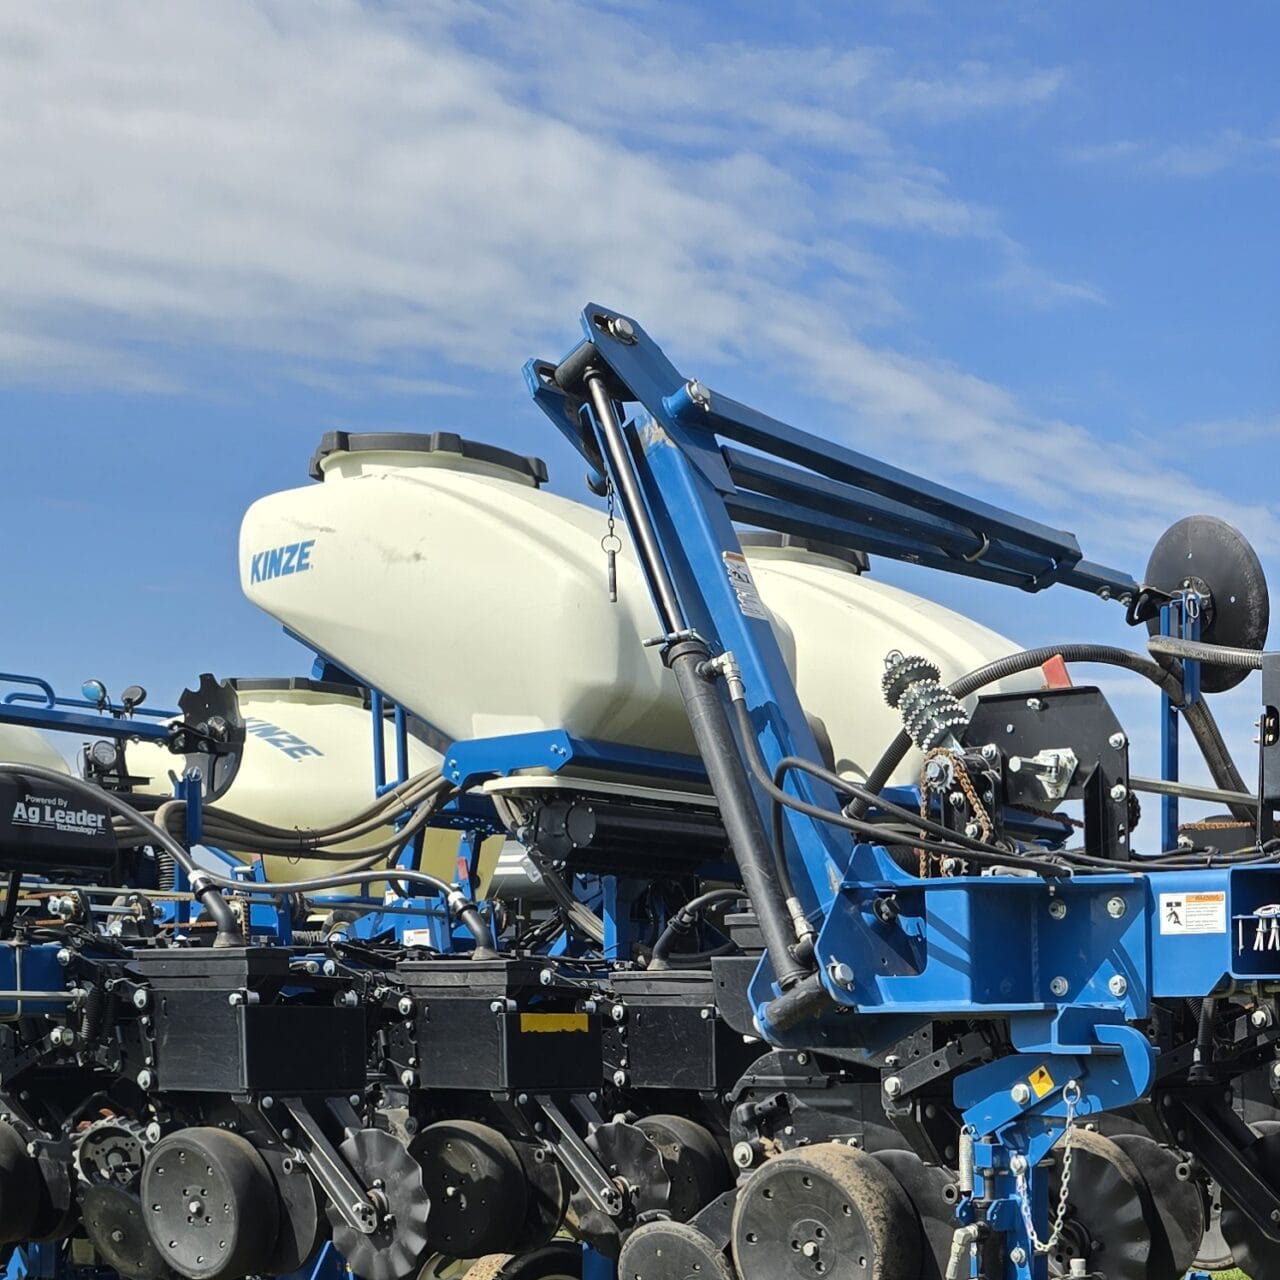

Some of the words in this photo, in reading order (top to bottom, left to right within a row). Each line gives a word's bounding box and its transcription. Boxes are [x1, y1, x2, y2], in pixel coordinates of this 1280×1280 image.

[250, 539, 316, 585] KINZE
[25, 793, 57, 805] Powered
[57, 797, 69, 808] By
[13, 801, 40, 824] Ag
[44, 805, 106, 827] Leader
[56, 823, 97, 835] Technology
